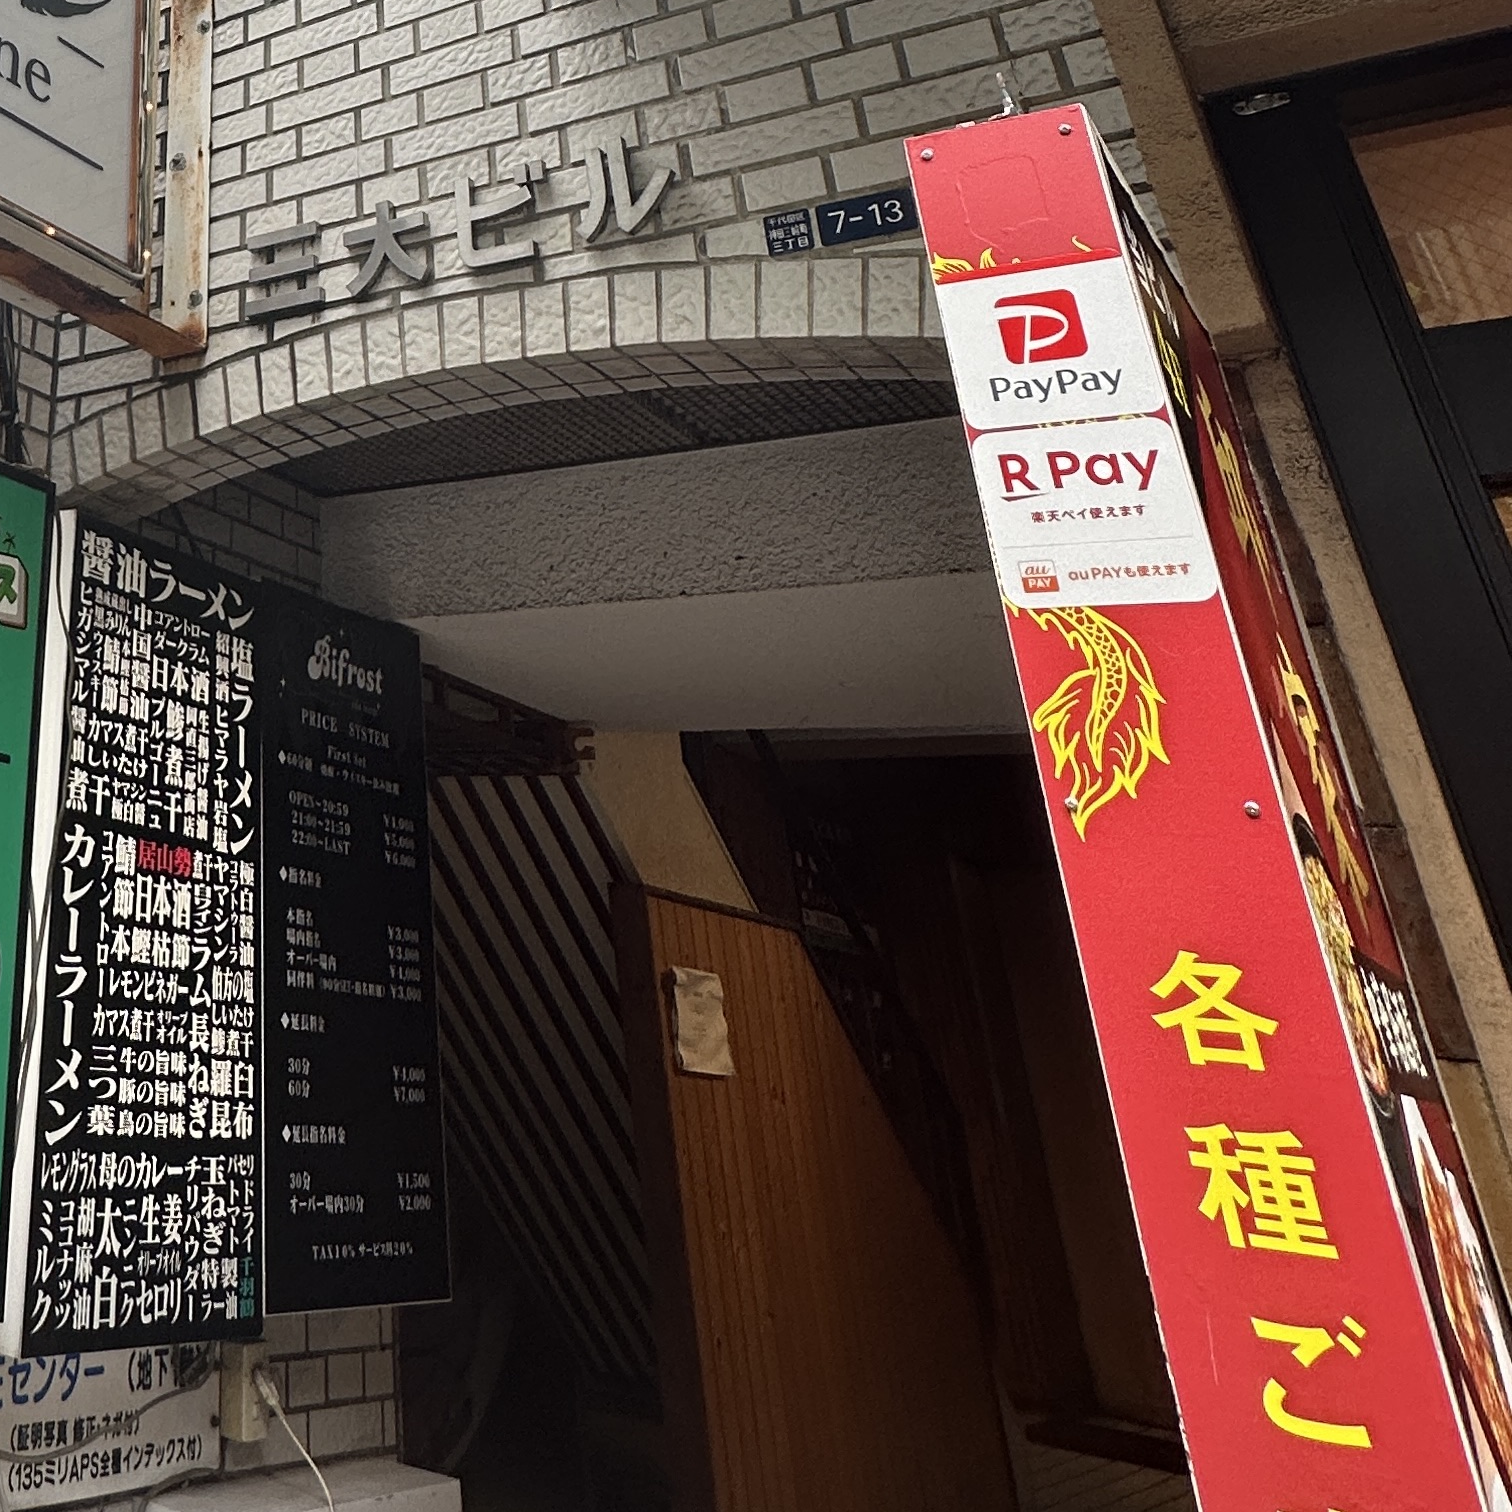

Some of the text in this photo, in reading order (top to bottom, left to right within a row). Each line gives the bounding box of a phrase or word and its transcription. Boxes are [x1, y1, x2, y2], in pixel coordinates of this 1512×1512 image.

[244, 136, 676, 322] 三大ビル
[826, 199, 906, 237] 7-13
[773, 237, 812, 255] 三丁目
[989, 368, 1122, 403] PayPay
[1045, 449, 1159, 491] Pay
[1030, 503, 1147, 524] 楽天ペイ使えます
[81, 529, 255, 630] 醤油ラーメン
[1024, 561, 1051, 576] au
[1028, 577, 1052, 589] PAY
[154, 610, 211, 638] コアントロー
[91, 630, 103, 708] ウィスキー
[131, 602, 152, 723] 中国醤油
[154, 631, 210, 665] ダークラム
[307, 635, 384, 695] Bifrost
[152, 654, 210, 705] 日本酒
[301, 707, 337, 733] PRICE
[87, 744, 149, 779] しいたけ
[230, 635, 255, 855] 塩ラーメン
[65, 766, 111, 816] 煮干
[96, 830, 114, 998] コアントロー
[136, 873, 192, 930] 日本酒
[213, 857, 230, 962] ヤマシン
[44, 823, 96, 1146] カレーラーメン
[109, 967, 189, 1005] レモンビネガー
[189, 937, 212, 1009] ラム
[157, 1025, 188, 1045] オイル
[212, 1004, 255, 1028] しいたけ
[119, 1046, 188, 1077] 牛の旨味
[188, 1012, 212, 1139] 長ねぎ
[287, 1057, 311, 1076] 30分
[86, 1044, 118, 1136] 三つ葉
[118, 1078, 187, 1106] 豚の旨味
[288, 1080, 311, 1099] 60分
[41, 1147, 97, 1193] レモングラス
[99, 1151, 184, 1191] 母のカレー
[289, 1171, 311, 1191] 30分
[139, 1192, 182, 1246] 生姜
[201, 1154, 227, 1256] 玉ねぎ
[1149, 949, 1373, 1512] 各種ご
[54, 1200, 76, 1330] ココナッツ
[72, 1196, 96, 1331] 胡麻油
[93, 1197, 123, 1331] 太白
[120, 1198, 139, 1327] ニンニク
[200, 1257, 238, 1289] 特製
[137, 1277, 182, 1325] セロリ
[200, 1289, 238, 1322] ラー油
